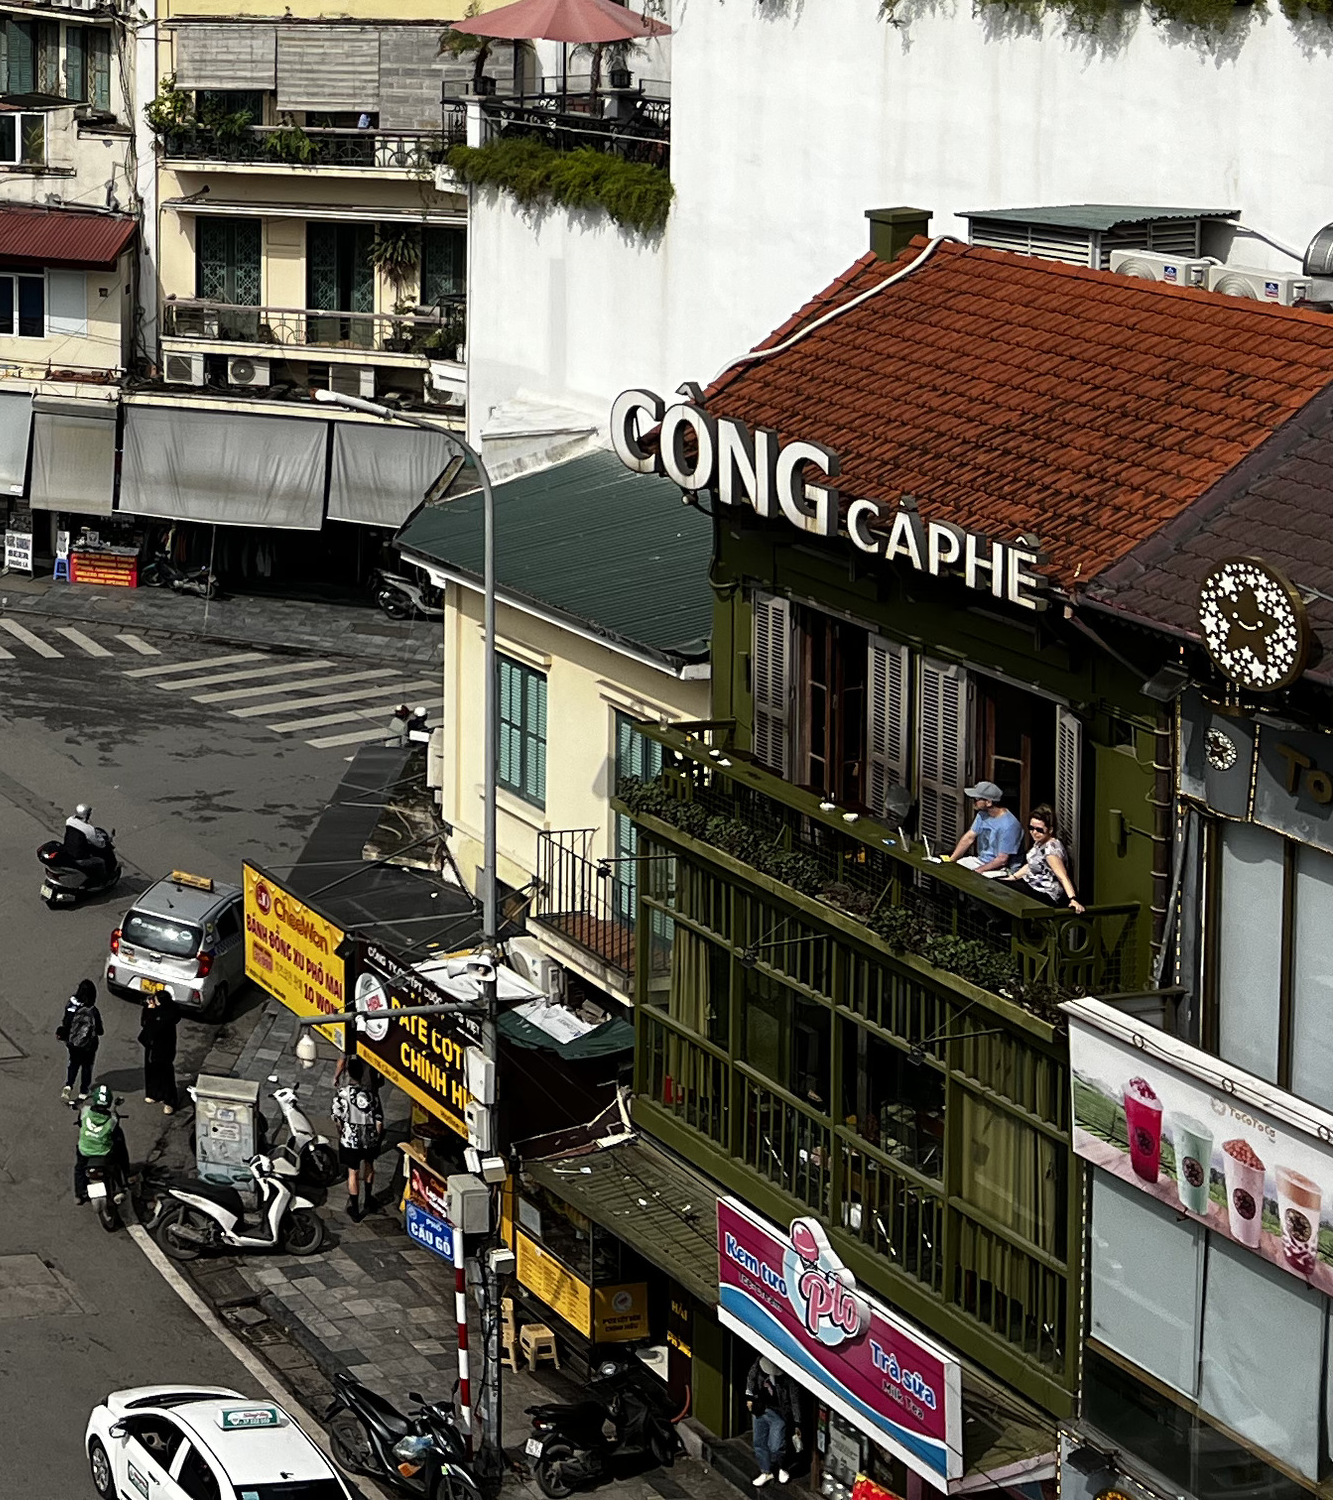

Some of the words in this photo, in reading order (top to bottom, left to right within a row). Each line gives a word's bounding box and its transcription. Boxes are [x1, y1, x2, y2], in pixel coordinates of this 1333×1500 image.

[7, 549, 29, 560] BEER
[246, 911, 268, 944] BÁNH
[293, 947, 305, 972] XU
[324, 971, 344, 1002] MAI
[303, 982, 315, 1006] 10
[400, 1041, 448, 1098] CHÍNH
[725, 1231, 761, 1278] Kem
[869, 1338, 901, 1384] Trà
[901, 1368, 937, 1411] sữa
[881, 1378, 905, 1406] Milk
[904, 1395, 925, 1421] Tea
